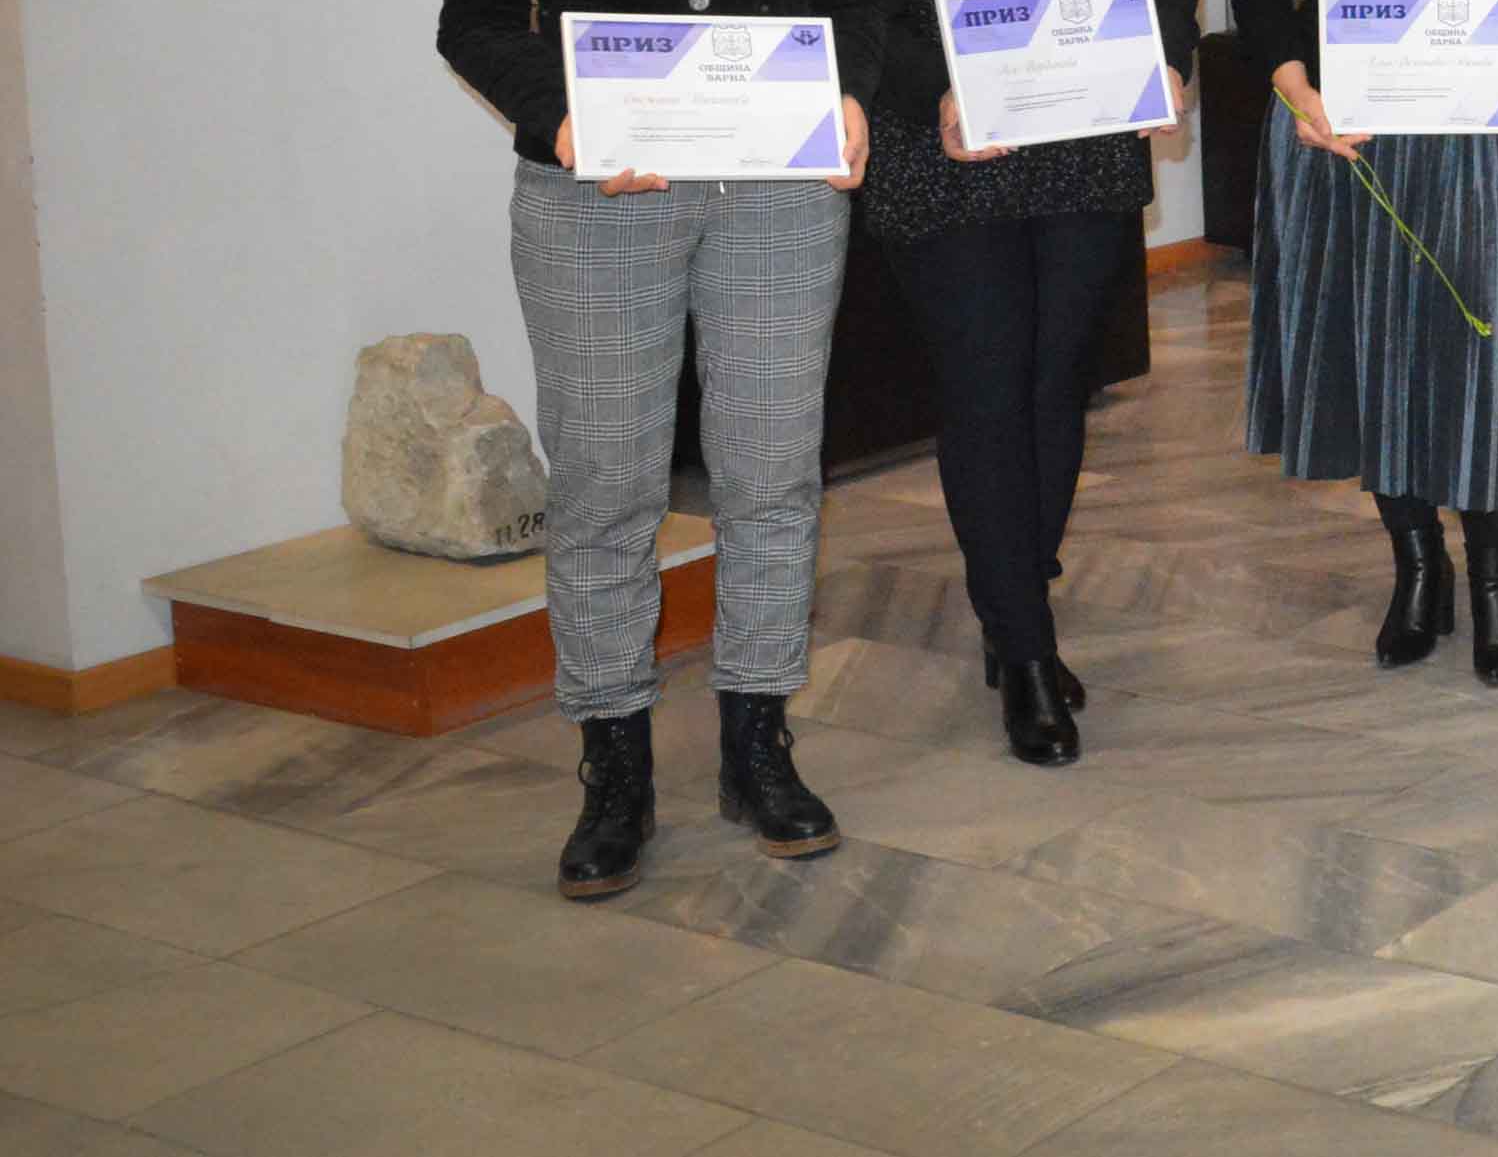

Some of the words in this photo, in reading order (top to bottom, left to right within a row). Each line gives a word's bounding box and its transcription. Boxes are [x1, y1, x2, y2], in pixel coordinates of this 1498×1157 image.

[963, 6, 1032, 28] ПРИЗ
[1340, 4, 1407, 20] ПРИЗ
[590, 35, 675, 54] ПРИЗ
